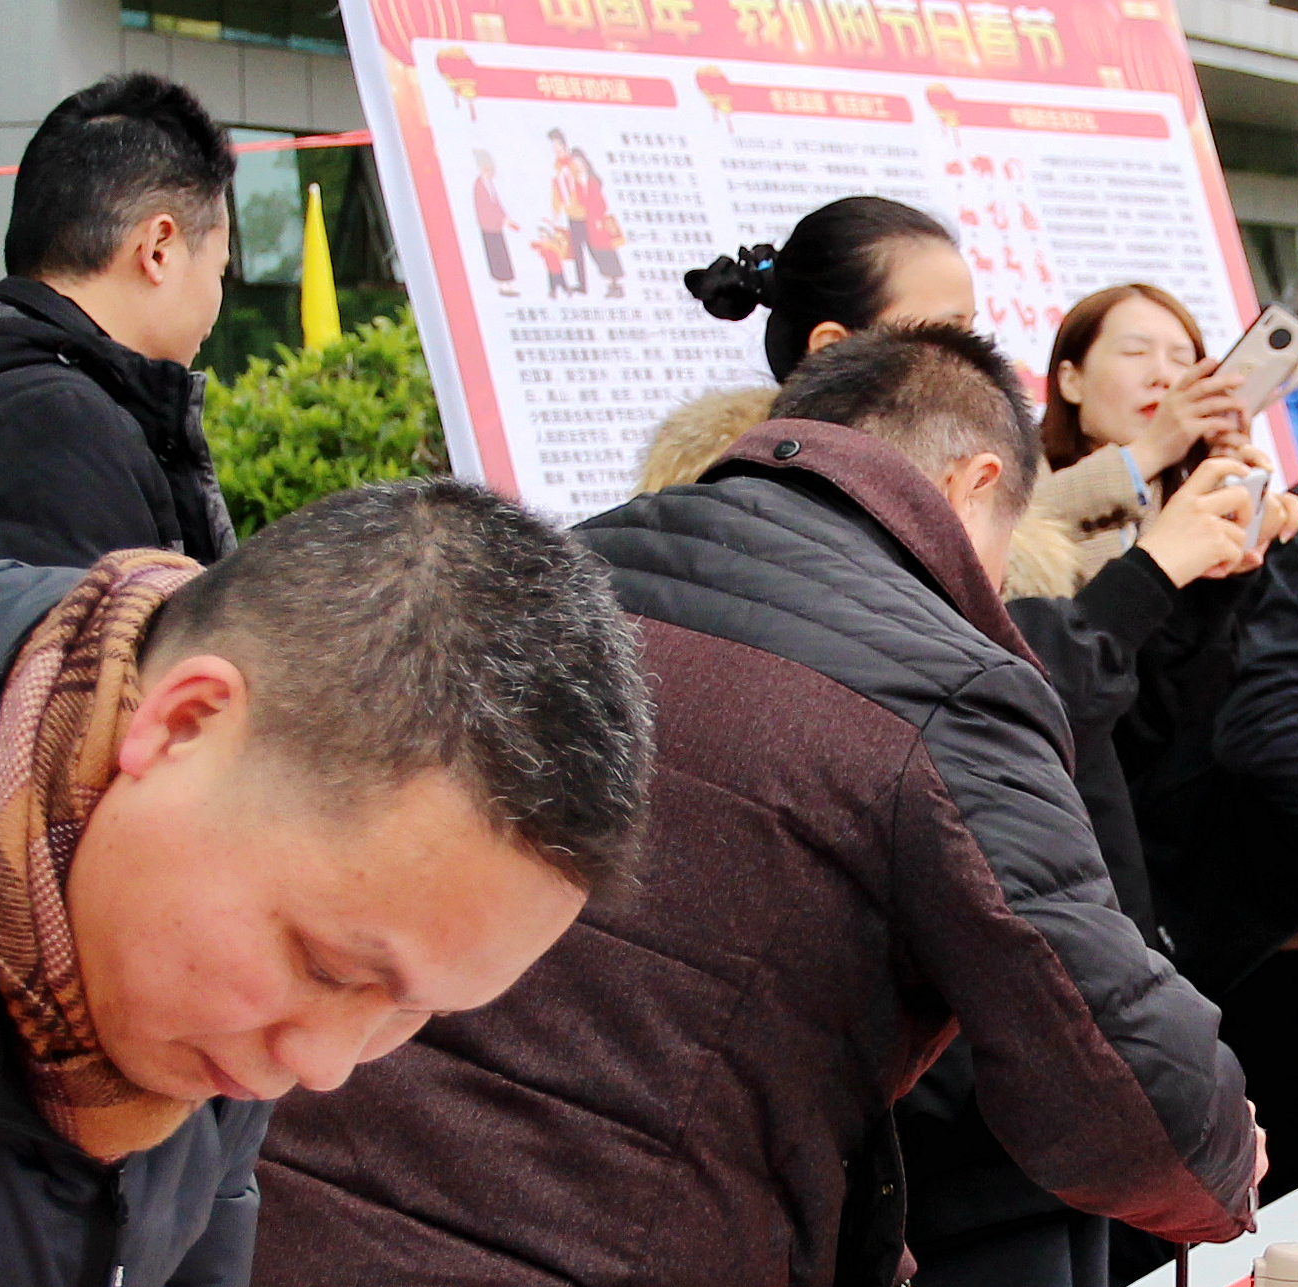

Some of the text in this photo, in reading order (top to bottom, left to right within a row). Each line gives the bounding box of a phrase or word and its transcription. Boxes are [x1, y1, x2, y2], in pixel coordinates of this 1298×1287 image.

[728, 0, 1066, 72] 我们的节日春节
